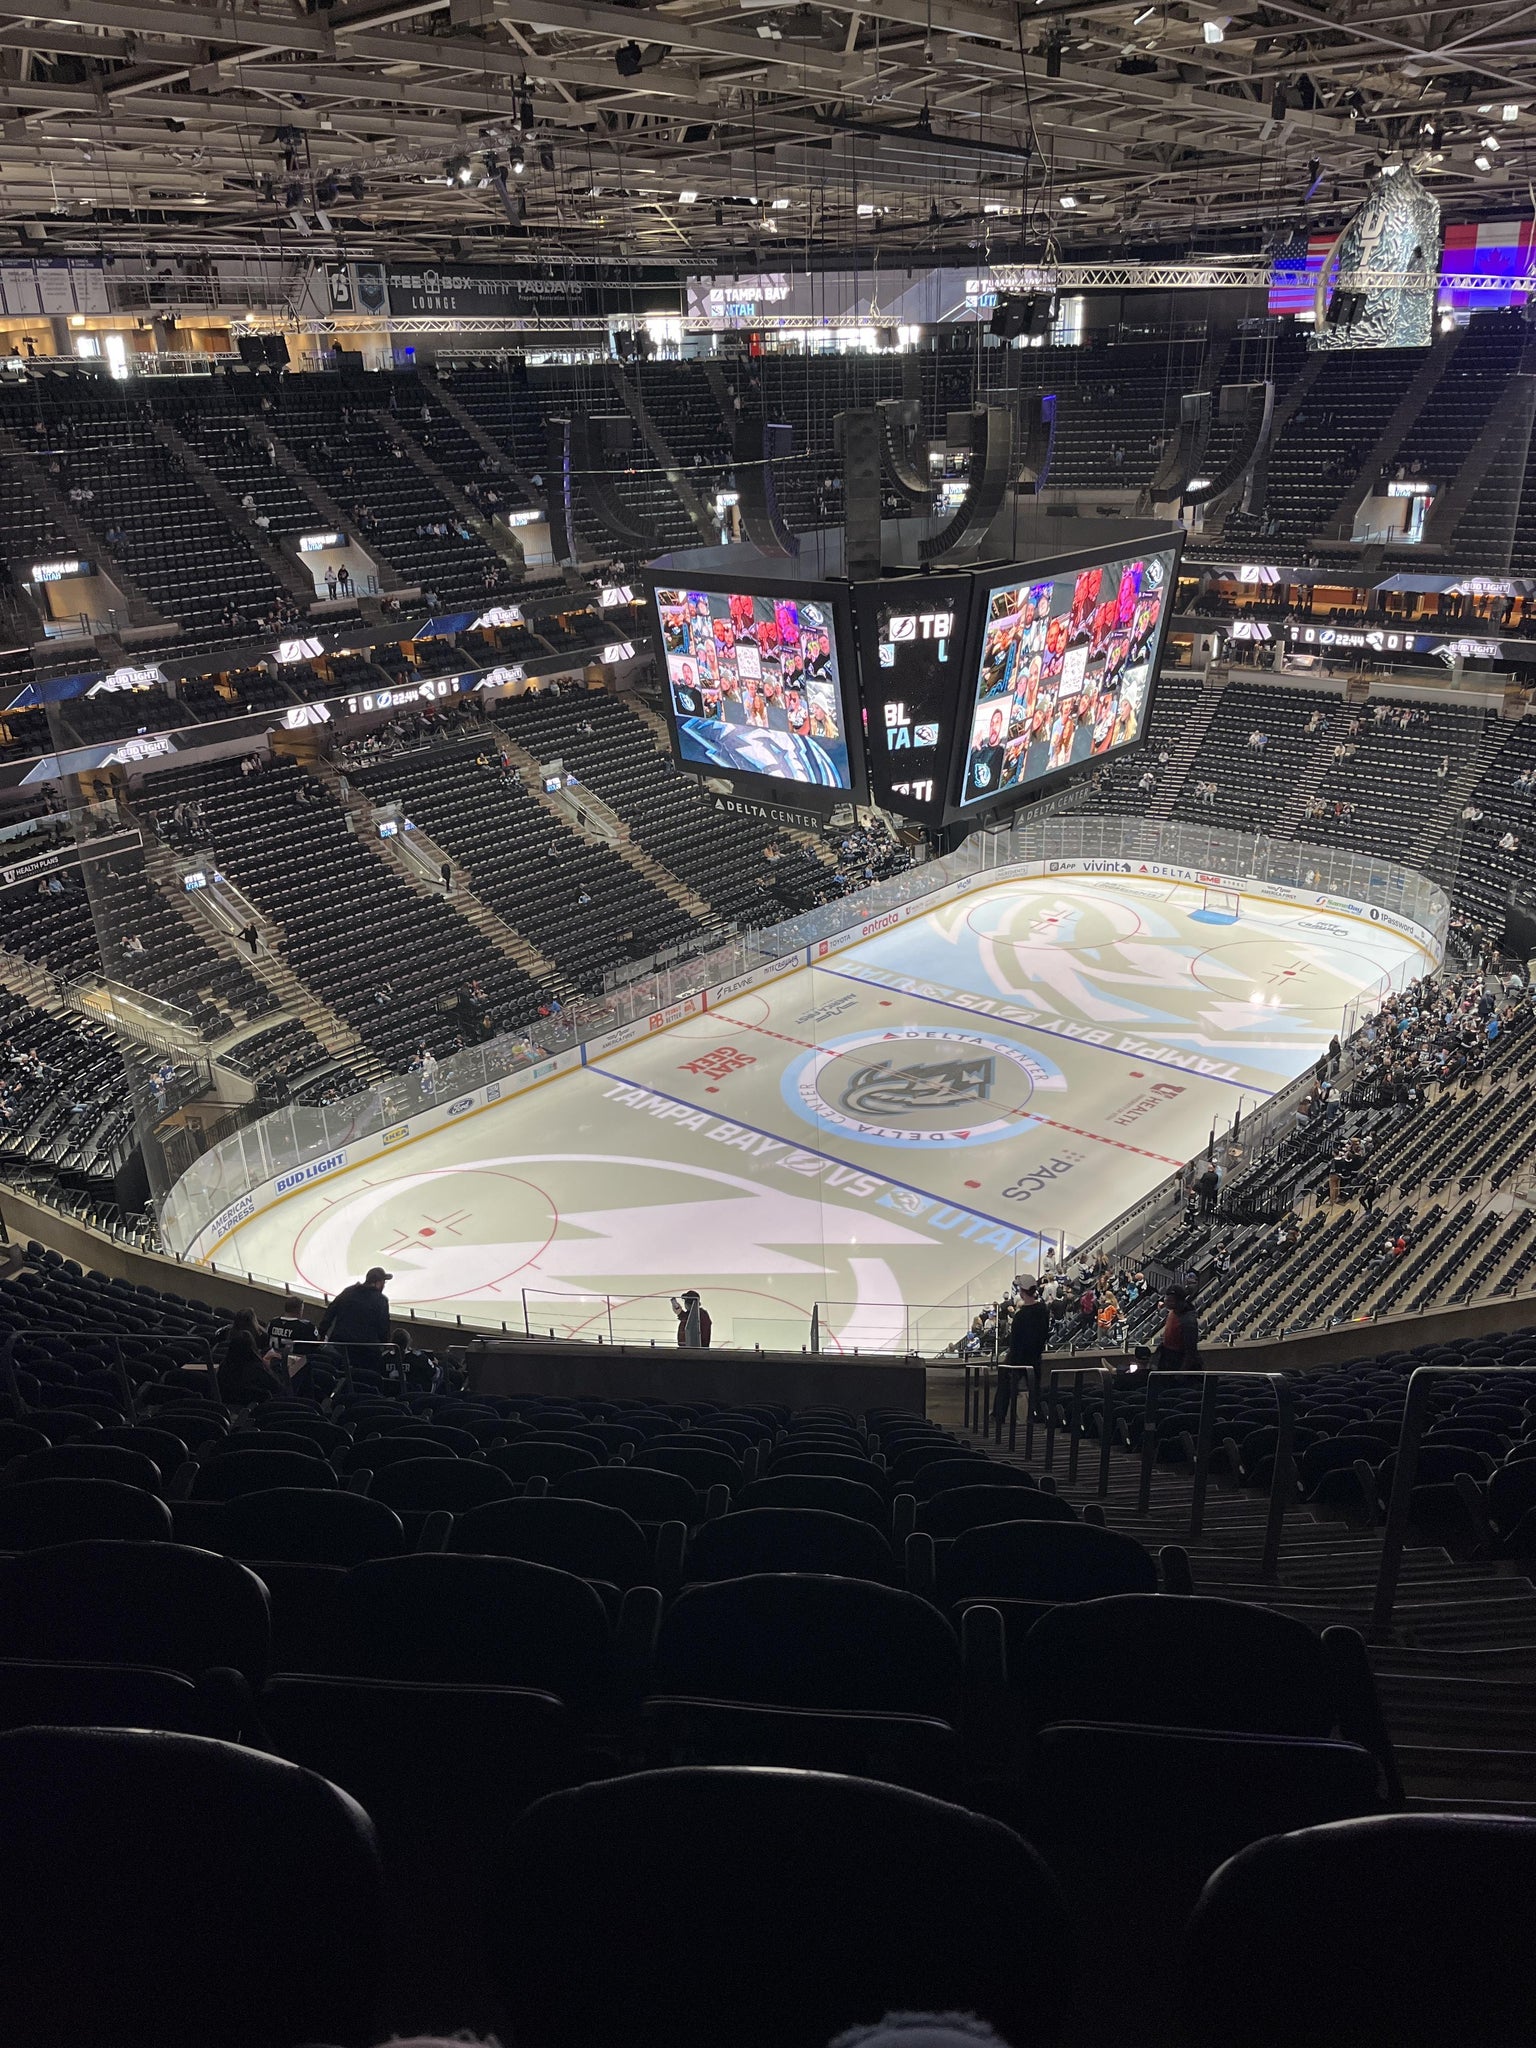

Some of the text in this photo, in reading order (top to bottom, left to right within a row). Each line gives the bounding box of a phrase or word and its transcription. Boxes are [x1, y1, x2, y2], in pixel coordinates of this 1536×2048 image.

[412, 296, 456, 310] LOUNGE
[724, 287, 789, 301] TAMPA BAY
[726, 304, 755, 317] UTAH
[1335, 634, 1365, 646] 22:44
[129, 671, 156, 683] LIGHT
[393, 690, 419, 706] 22:44
[139, 741, 167, 755] LIGHT
[726, 800, 818, 828] DELTA CENTER
[1027, 787, 1089, 821] DELTA CENTER
[16, 862, 39, 876] HEALTH
[40, 856, 59, 868] PLANS
[1152, 866, 1191, 880] DELTA
[1199, 874, 1221, 884] SME
[1327, 899, 1363, 915] SameDay
[862, 912, 899, 936] entrata
[1380, 913, 1414, 934] 1Password
[829, 934, 851, 948] TOYOTA
[723, 976, 753, 995] FILEVINE
[649, 1013, 664, 1031] PB
[676, 1046, 738, 1074] GEEK
[906, 1031, 1049, 1081] DELTA CENTER
[703, 1053, 758, 1081] SEAT
[450, 1099, 471, 1115] Ford
[800, 1083, 945, 1141] DELTA CENTER
[1113, 1096, 1163, 1126] HEALTH
[602, 1082, 788, 1157] TAMPA BAY
[386, 1127, 409, 1143] IKEA
[277, 1153, 344, 1192] BUD LIGHT
[824, 1166, 886, 1198] VS
[1002, 1157, 1074, 1202] PACS
[210, 1196, 253, 1234] AMERICAN
[217, 1206, 255, 1238] EXPRESS
[927, 1205, 1048, 1264] UTAH
